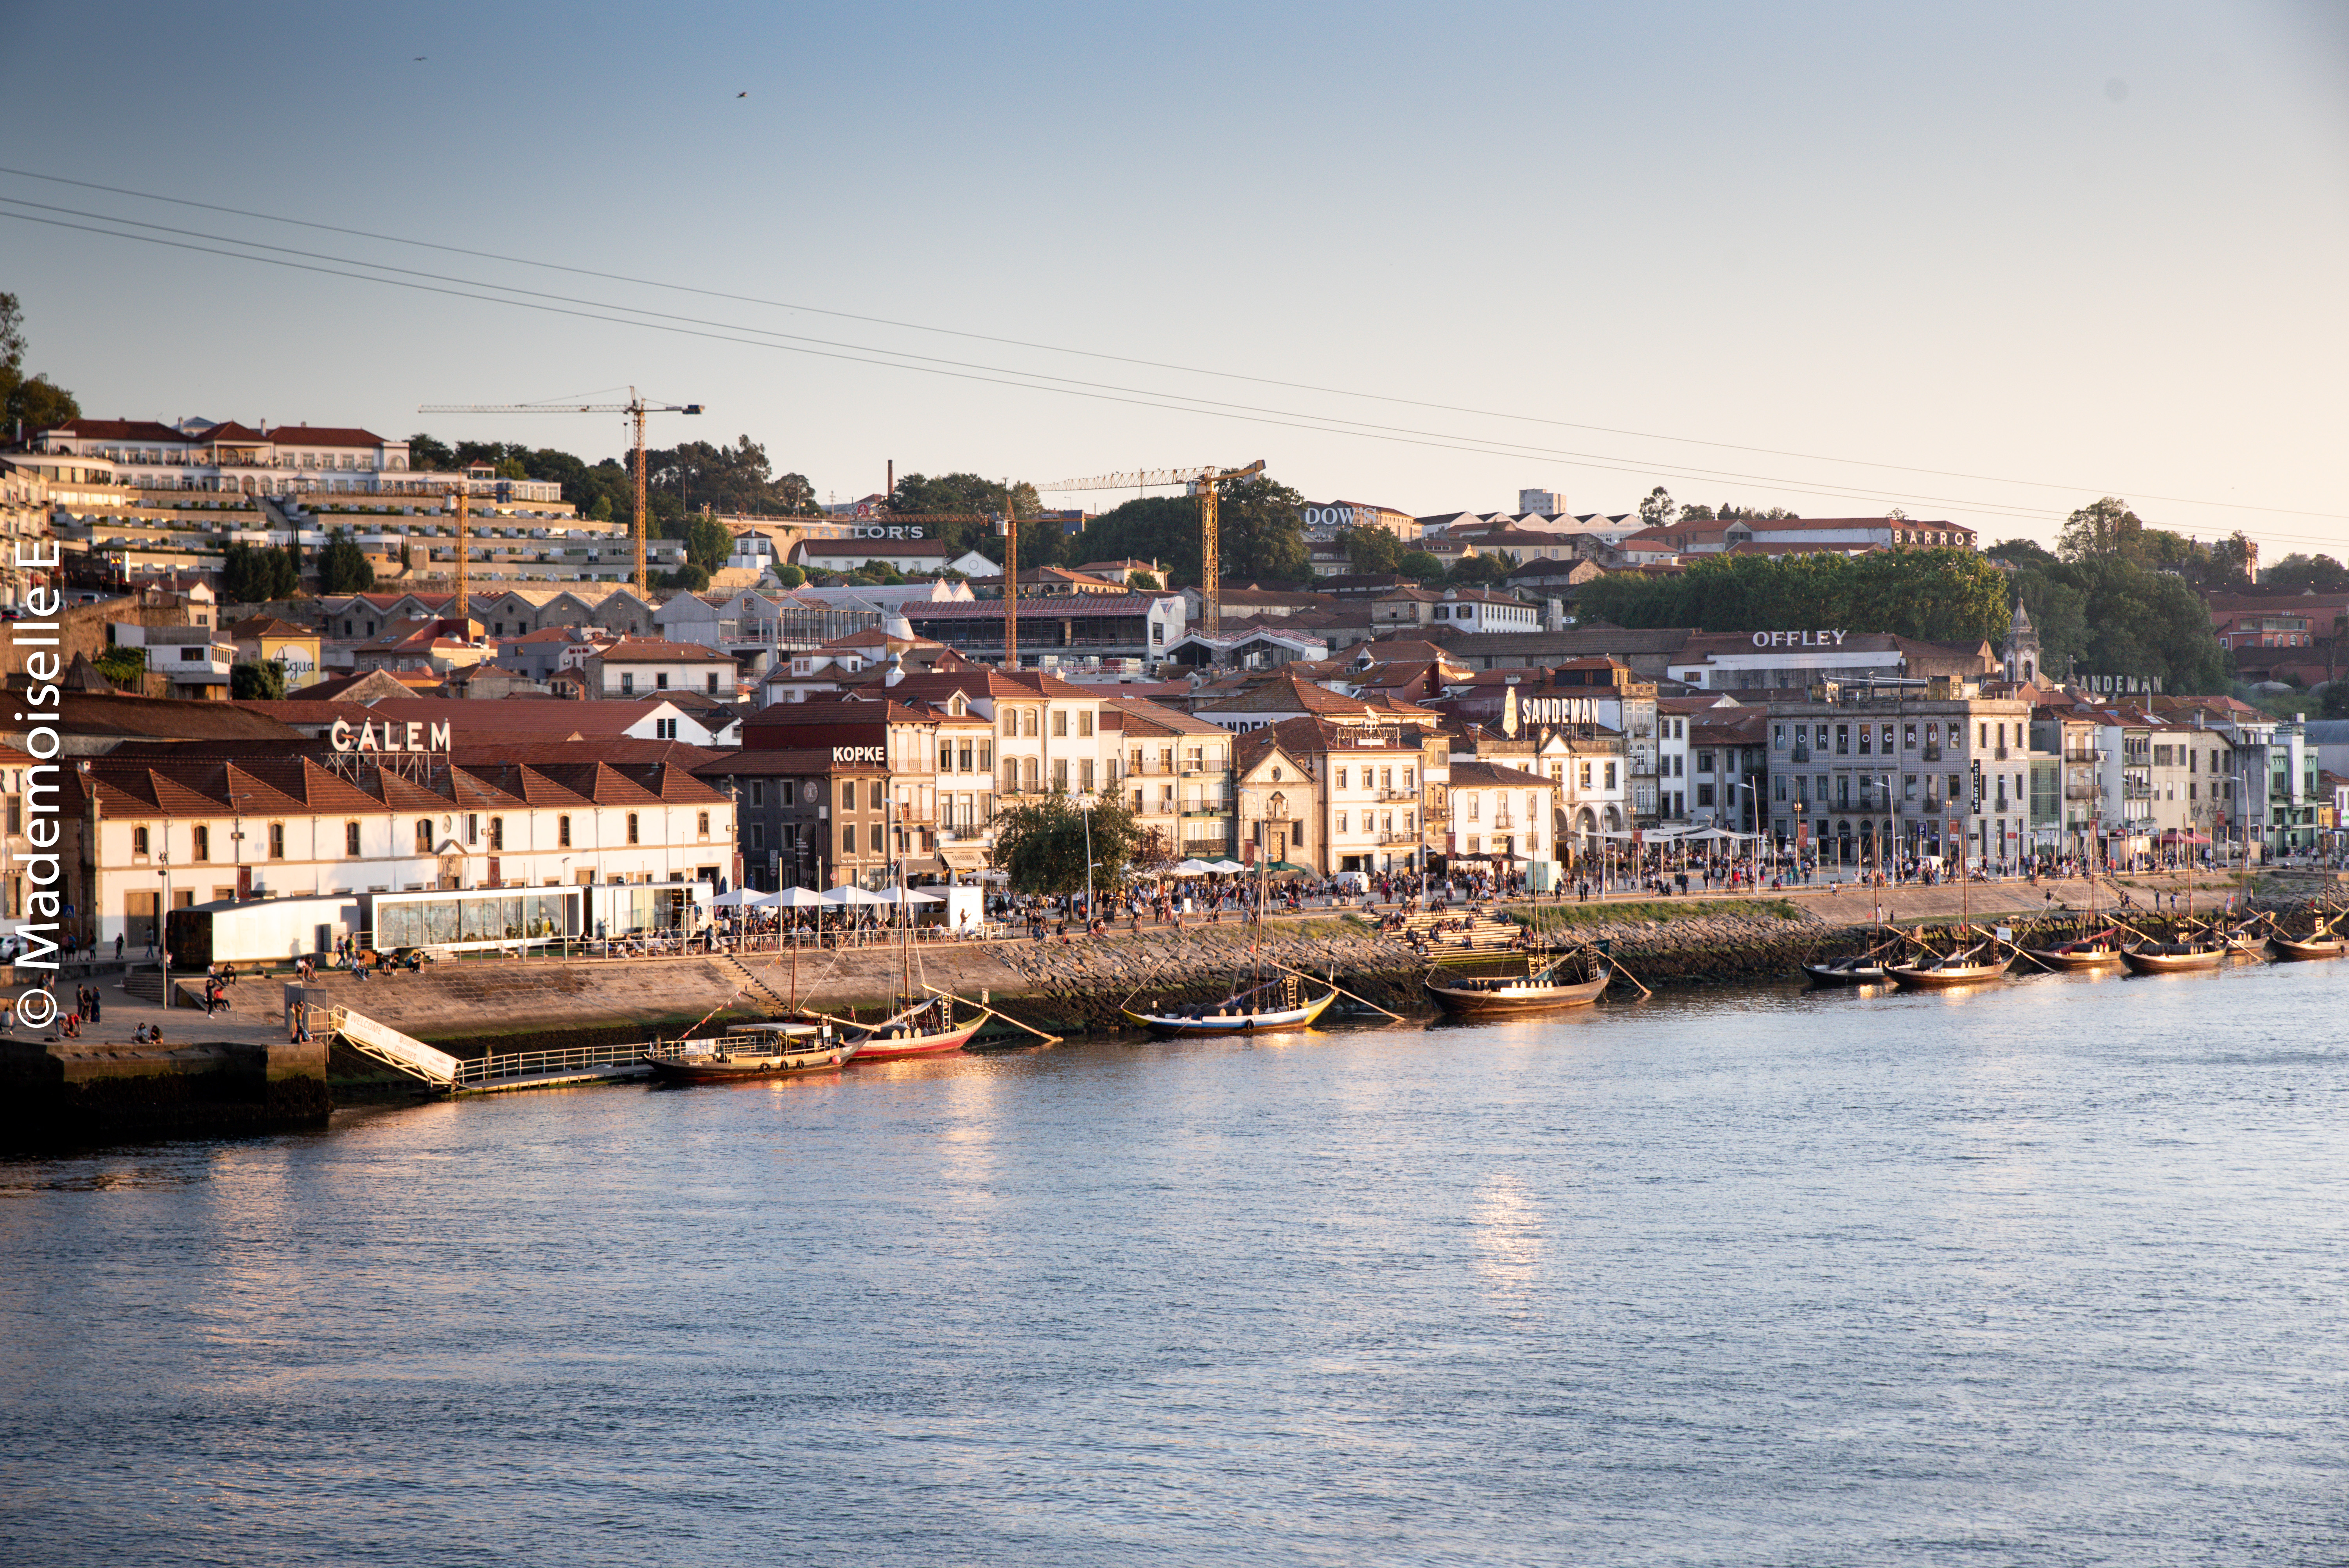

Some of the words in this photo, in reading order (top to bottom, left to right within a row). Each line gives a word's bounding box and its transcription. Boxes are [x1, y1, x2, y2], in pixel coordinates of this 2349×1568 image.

[1306, 507, 1376, 524] DOW'S
[802, 526, 923, 540] TAYLOR'S
[1753, 629, 1848, 647] OFFLEY
[2080, 675, 2162, 692] ANDEMAN
[1522, 699, 1598, 724] SANDEMAN
[1340, 727, 1368, 740] QUINTA
[1778, 735, 1870, 743] PORTO
[1884, 732, 1959, 742] CRUZ
[833, 747, 884, 761] KOPKE
[350, 1014, 383, 1035] WELCOME
[399, 1036, 417, 1049] DOURO
[395, 1045, 417, 1060] CRUISES
